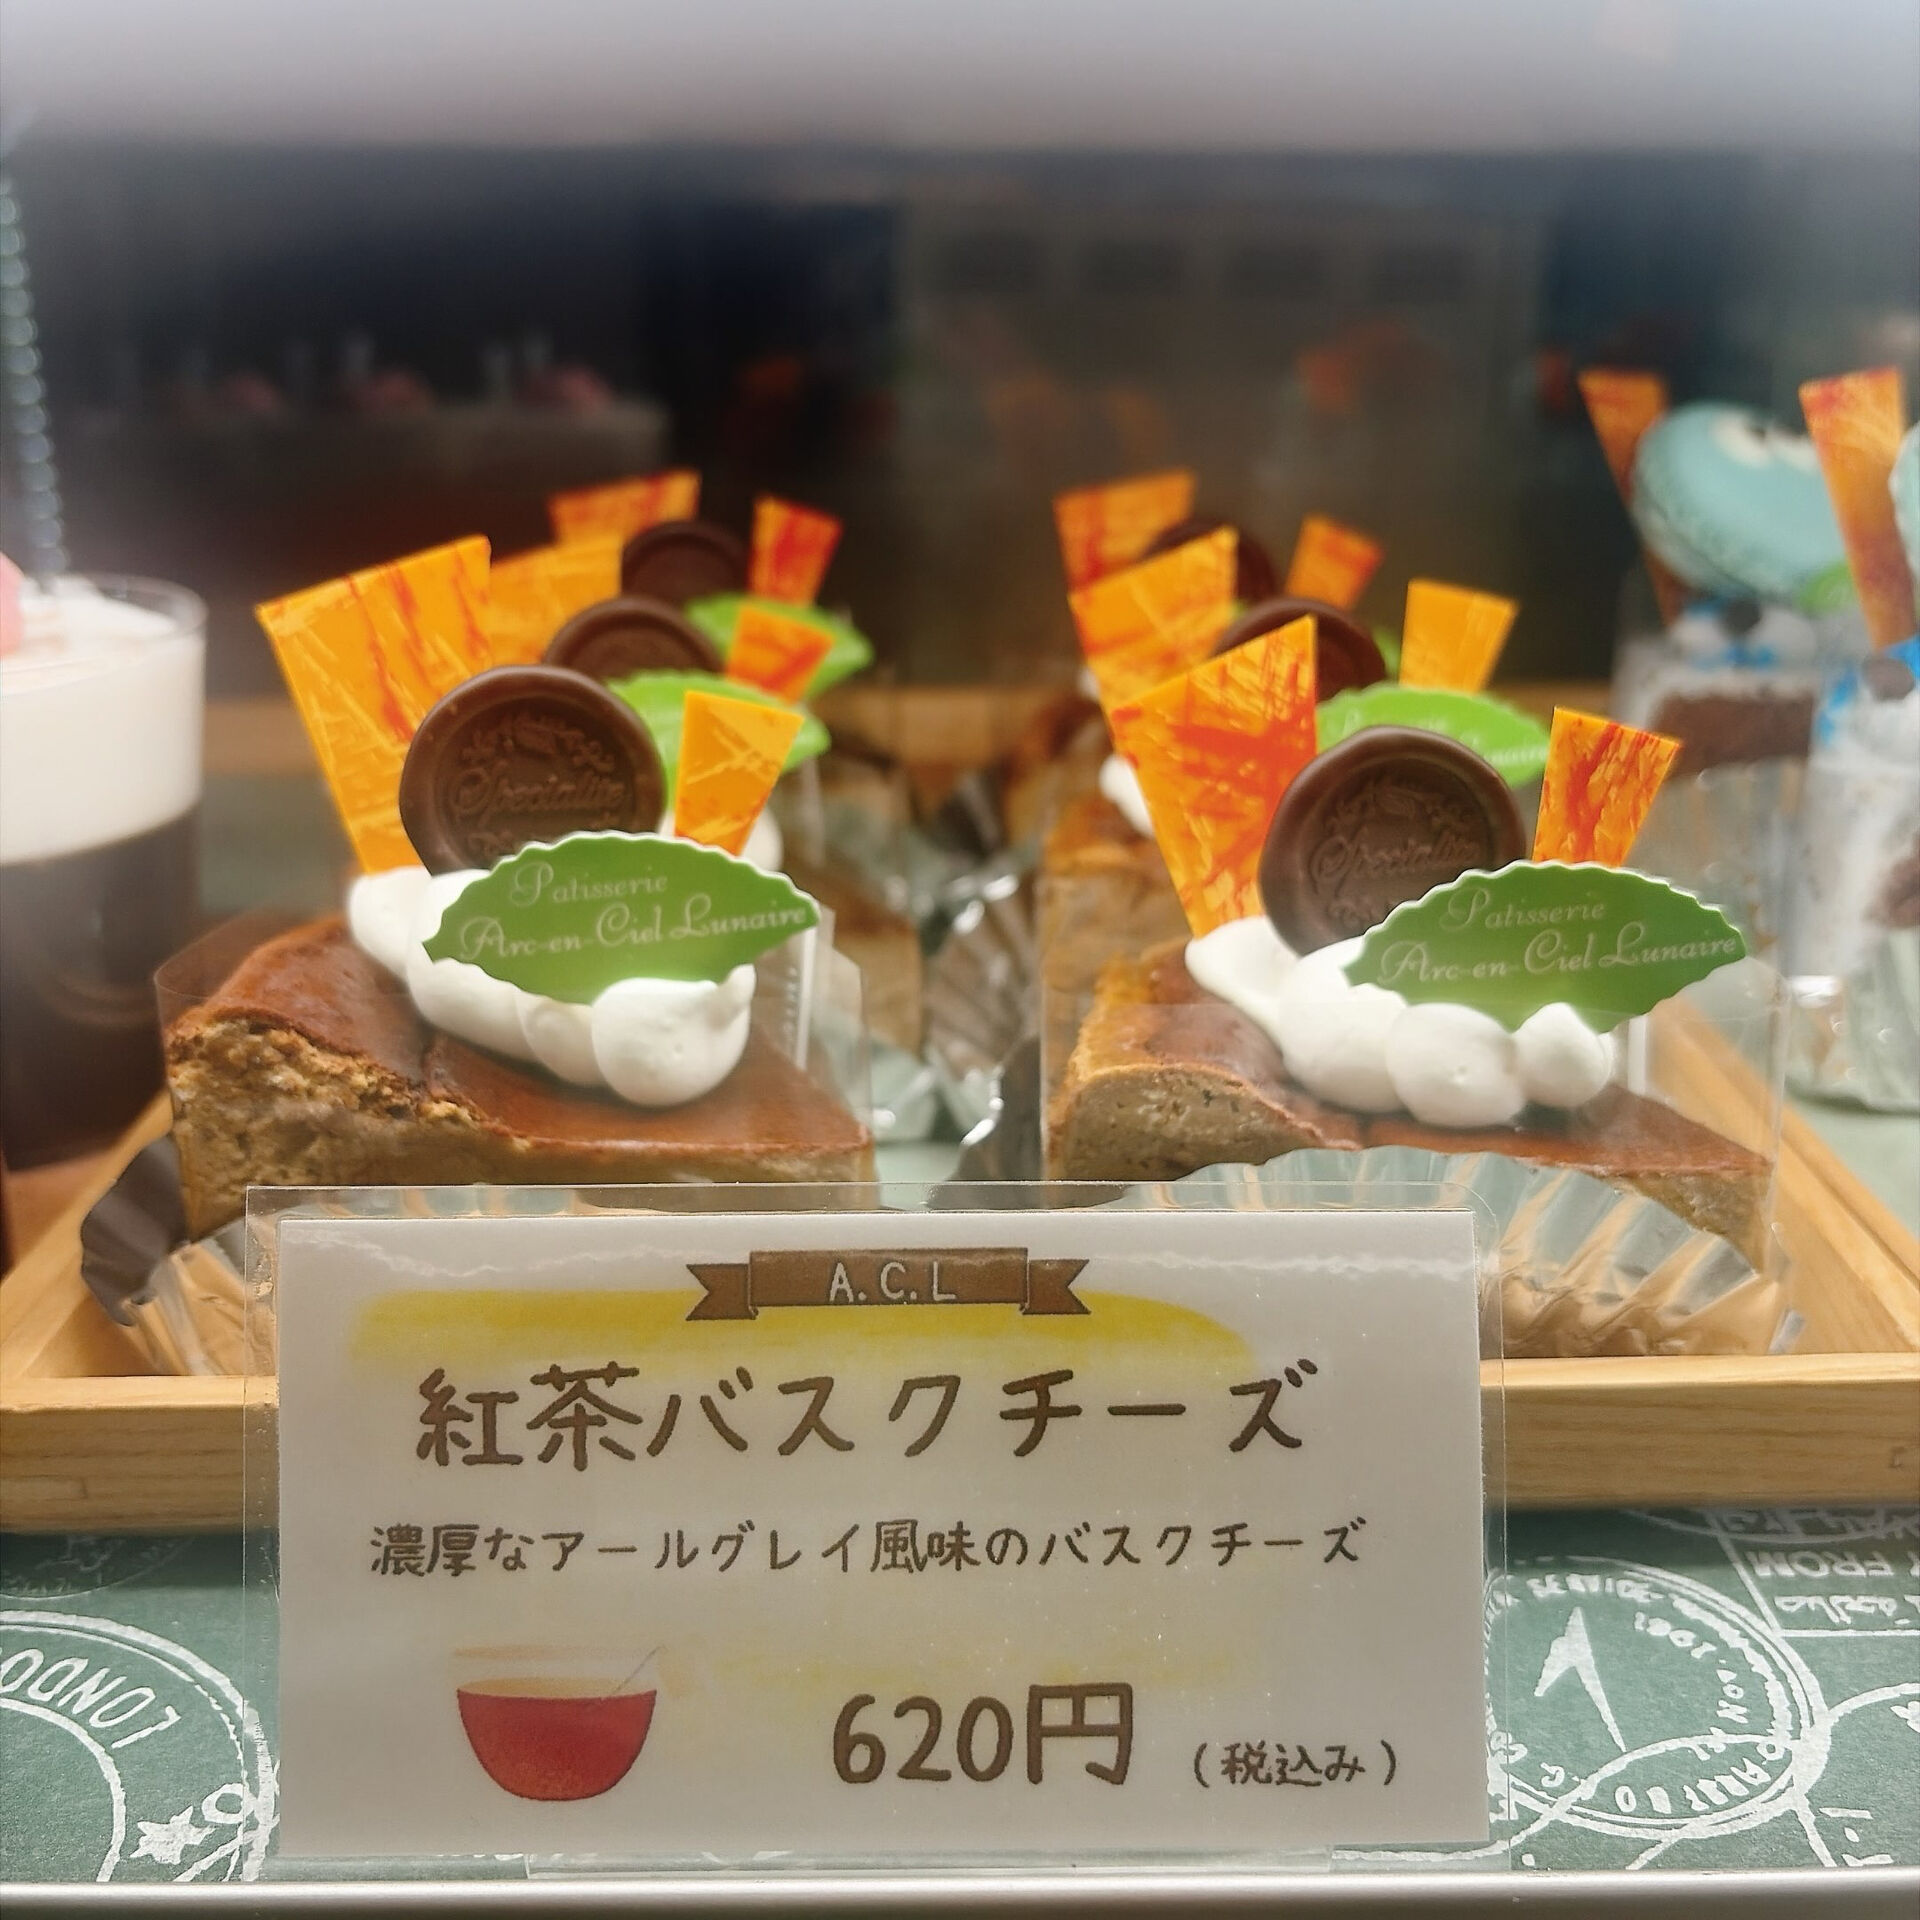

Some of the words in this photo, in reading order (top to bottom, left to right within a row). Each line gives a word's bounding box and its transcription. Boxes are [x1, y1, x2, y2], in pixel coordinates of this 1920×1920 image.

[508, 860, 669, 907] Patisserie
[1440, 887, 1606, 933] Patisserie
[460, 903, 663, 962] Arc-en-Ciel
[669, 892, 807, 940] Lunaire
[1380, 929, 1594, 986] Arc-en-Ciel
[1598, 922, 1738, 969] Lunaire
[415, 1359, 1319, 1472] 紅茶バスクチーズ
[369, 1516, 1367, 1577] 濃厚なアールグレイ風味のバスクチーズ
[1745, 1551, 1895, 1577] FROM
[0, 1648, 182, 1749] LONDO
[832, 1682, 1134, 1786] 620円
